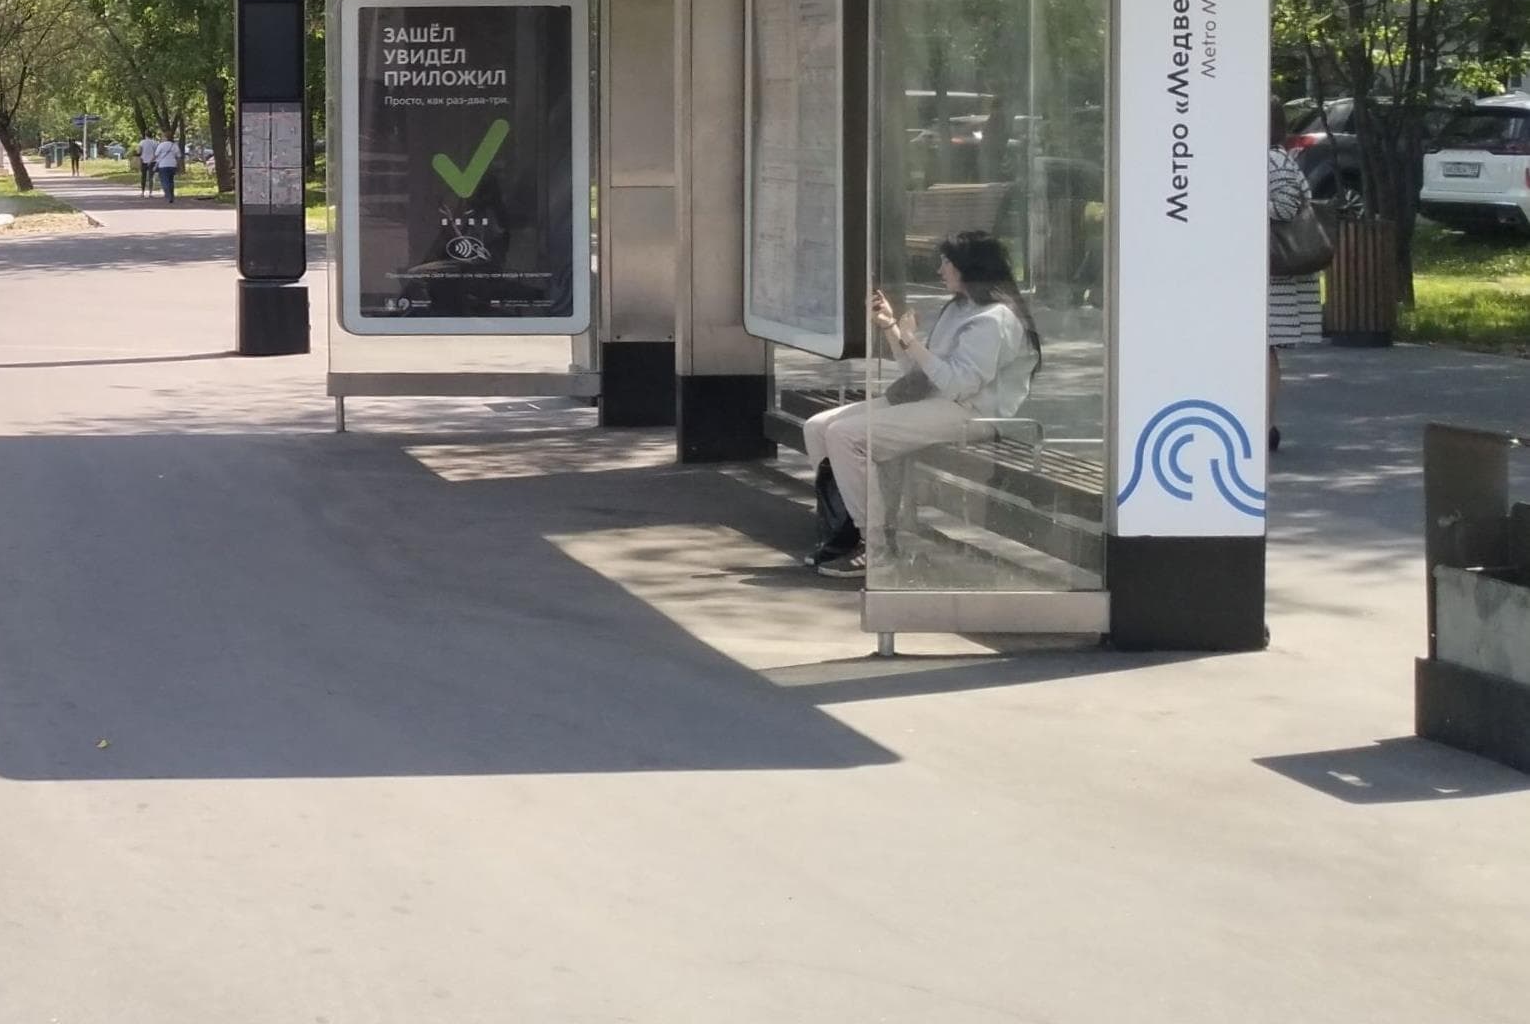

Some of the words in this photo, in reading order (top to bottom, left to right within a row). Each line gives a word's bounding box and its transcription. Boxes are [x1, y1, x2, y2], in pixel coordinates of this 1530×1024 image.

[383, 23, 454, 43] ЗАШЁЛ
[383, 48, 466, 67] УВИДЕЛ
[1200, 20, 1218, 79] Metro
[384, 70, 506, 87] ПРИЛОЖИЛ
[384, 95, 425, 107] Просто,
[426, 97, 444, 106] как
[1165, 123, 1194, 224] Метро
